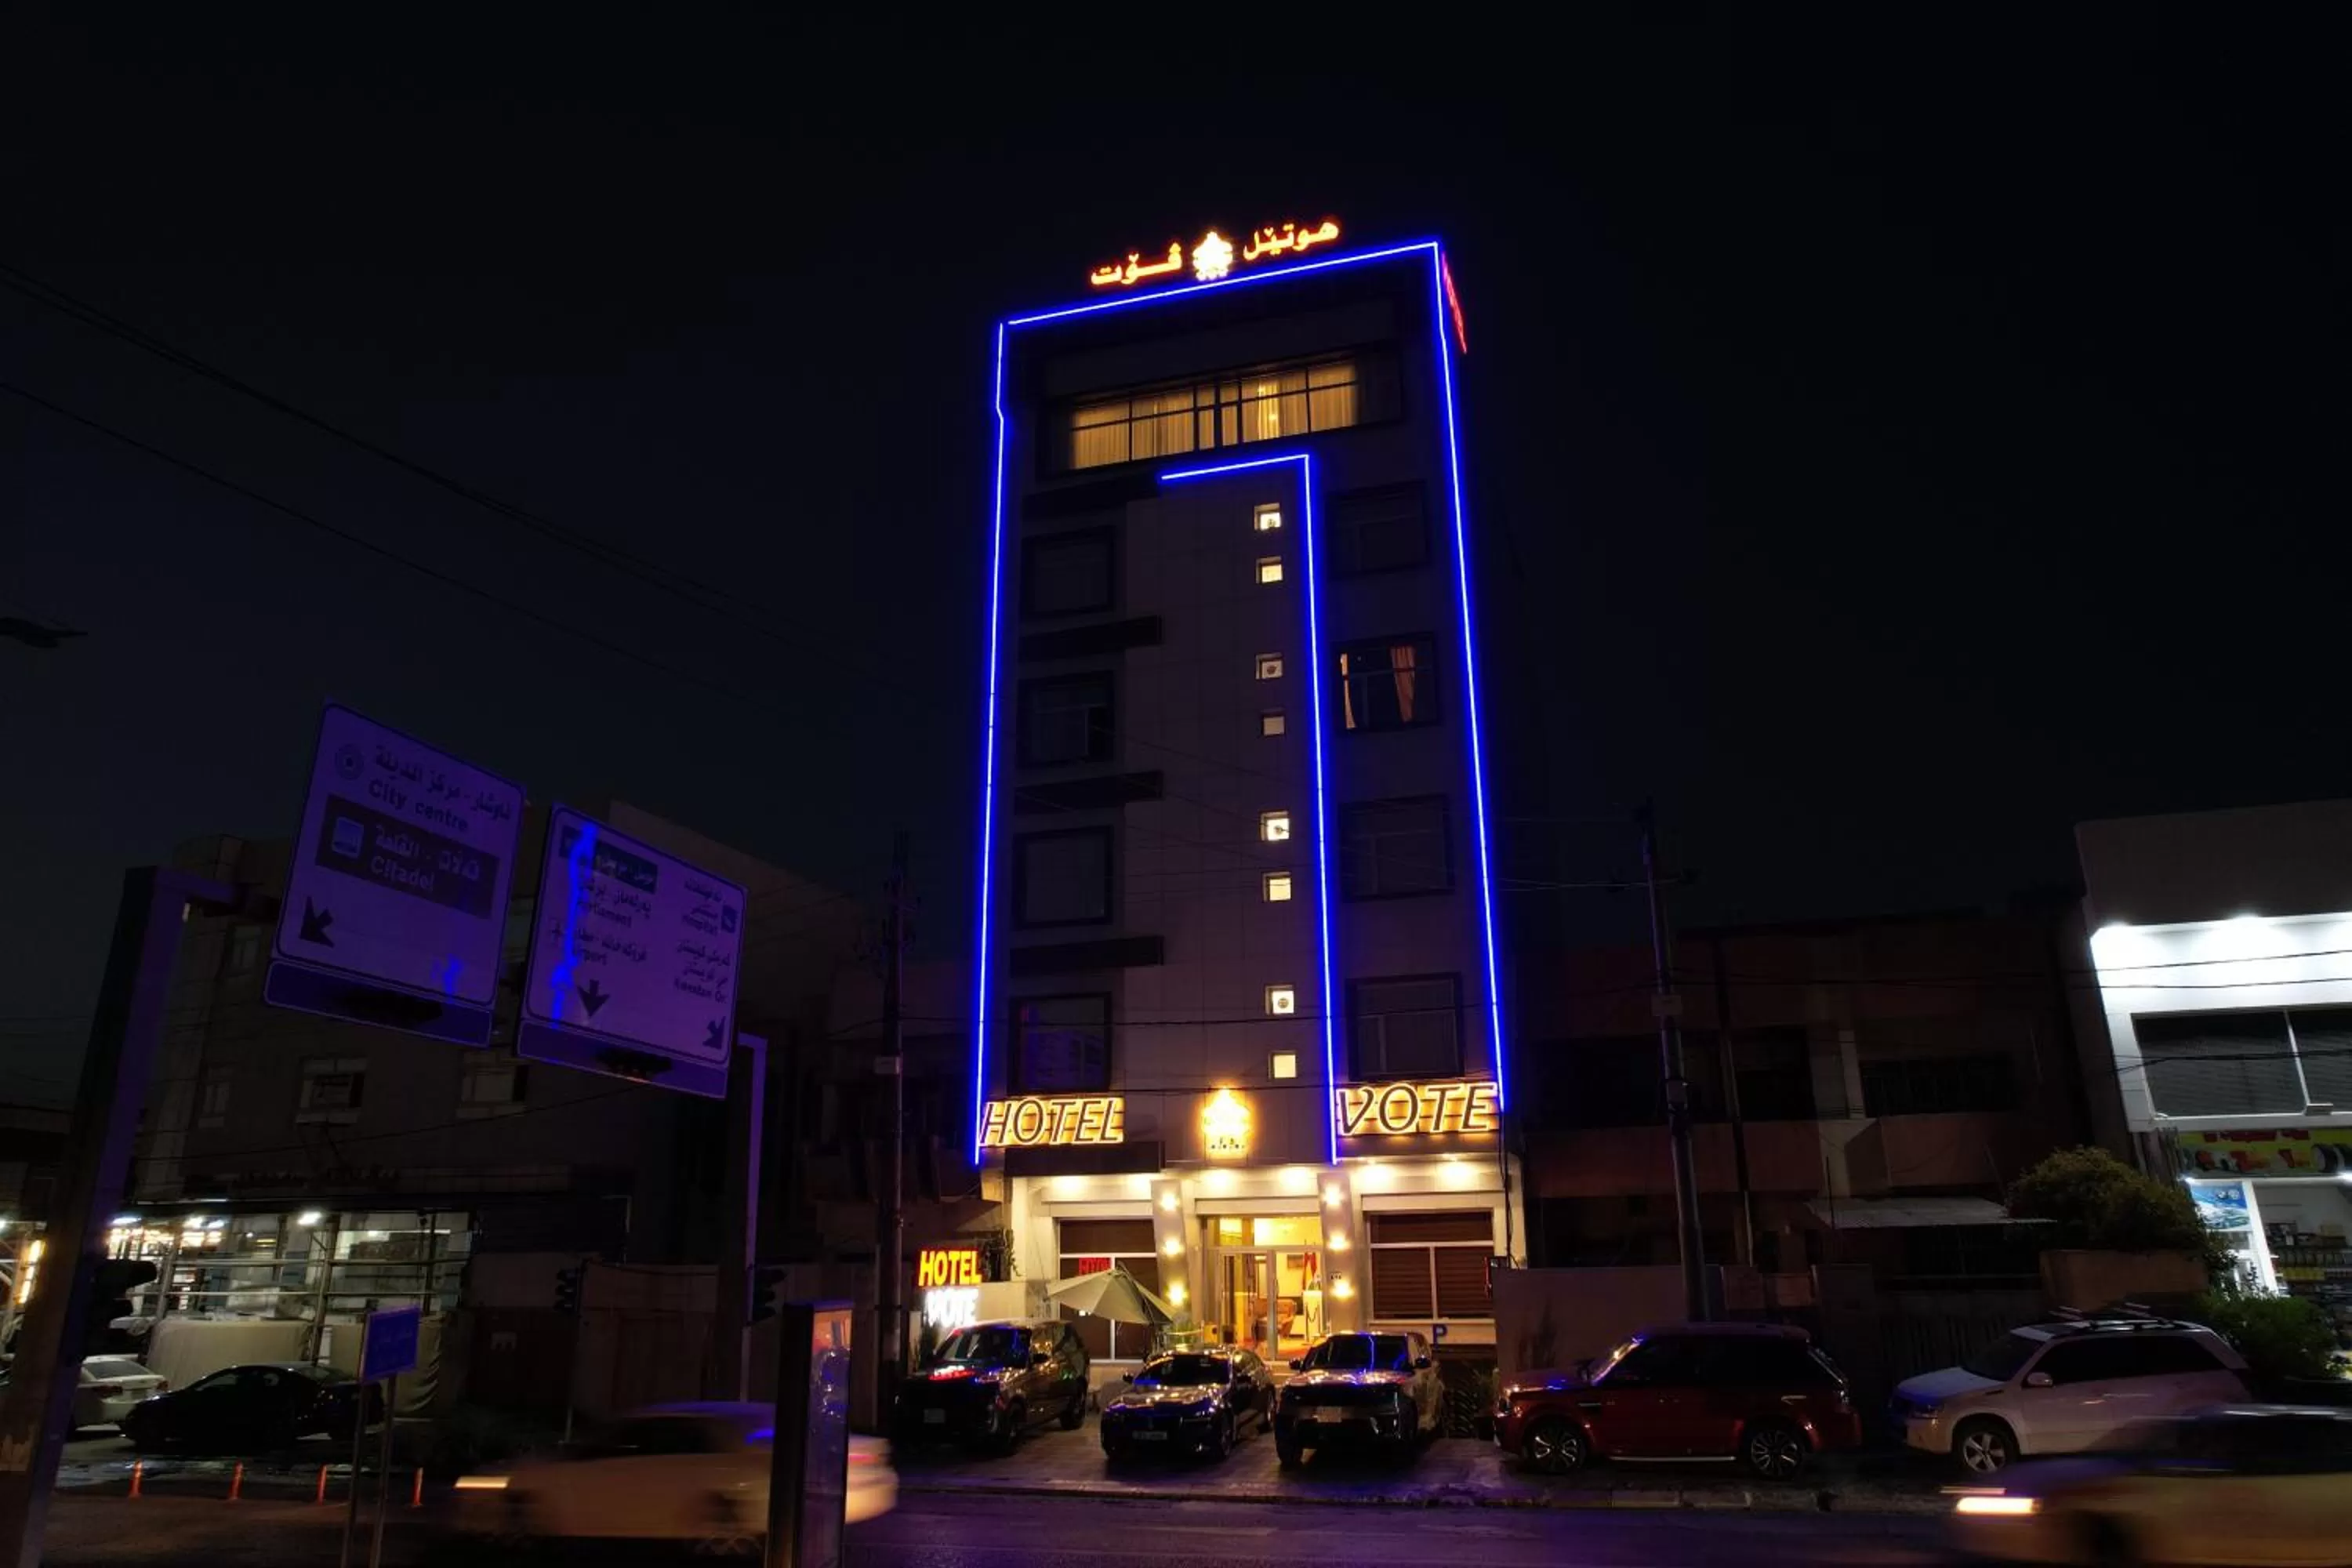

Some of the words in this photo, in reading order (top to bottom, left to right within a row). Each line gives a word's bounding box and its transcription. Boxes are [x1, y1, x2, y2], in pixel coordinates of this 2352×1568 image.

[368, 778, 408, 811] City
[415, 801, 469, 831] centre
[371, 855, 435, 894] Citadel
[980, 1096, 1125, 1147] HOTEL
[1336, 1081, 1498, 1134] VOTE
[918, 1250, 983, 1287] HOTEL
[925, 1288, 979, 1327] VOTE
